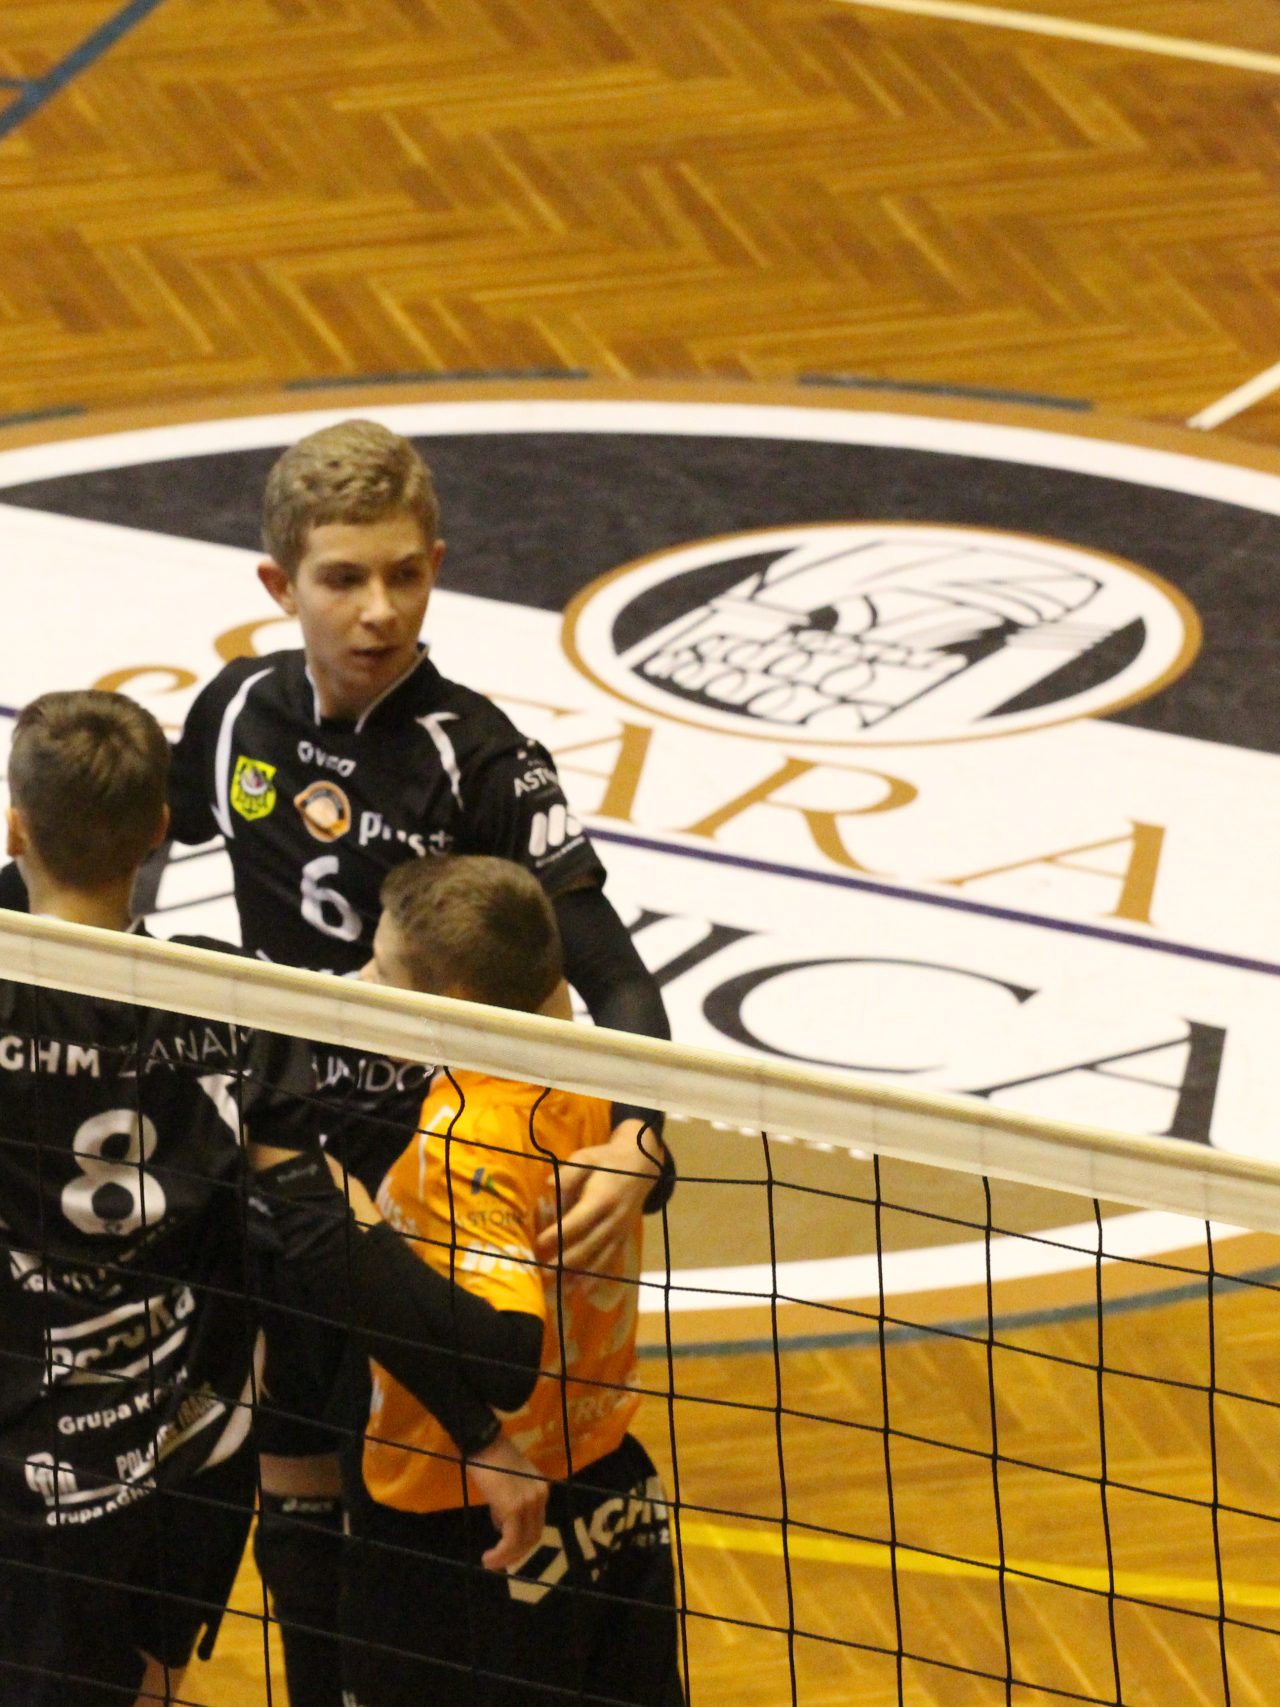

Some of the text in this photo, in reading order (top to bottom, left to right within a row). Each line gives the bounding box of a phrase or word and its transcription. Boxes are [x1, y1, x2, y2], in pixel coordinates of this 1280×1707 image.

[300, 855, 363, 943] 6
[61, 1108, 167, 1236] 8
[57, 1403, 132, 1436] Grupa
